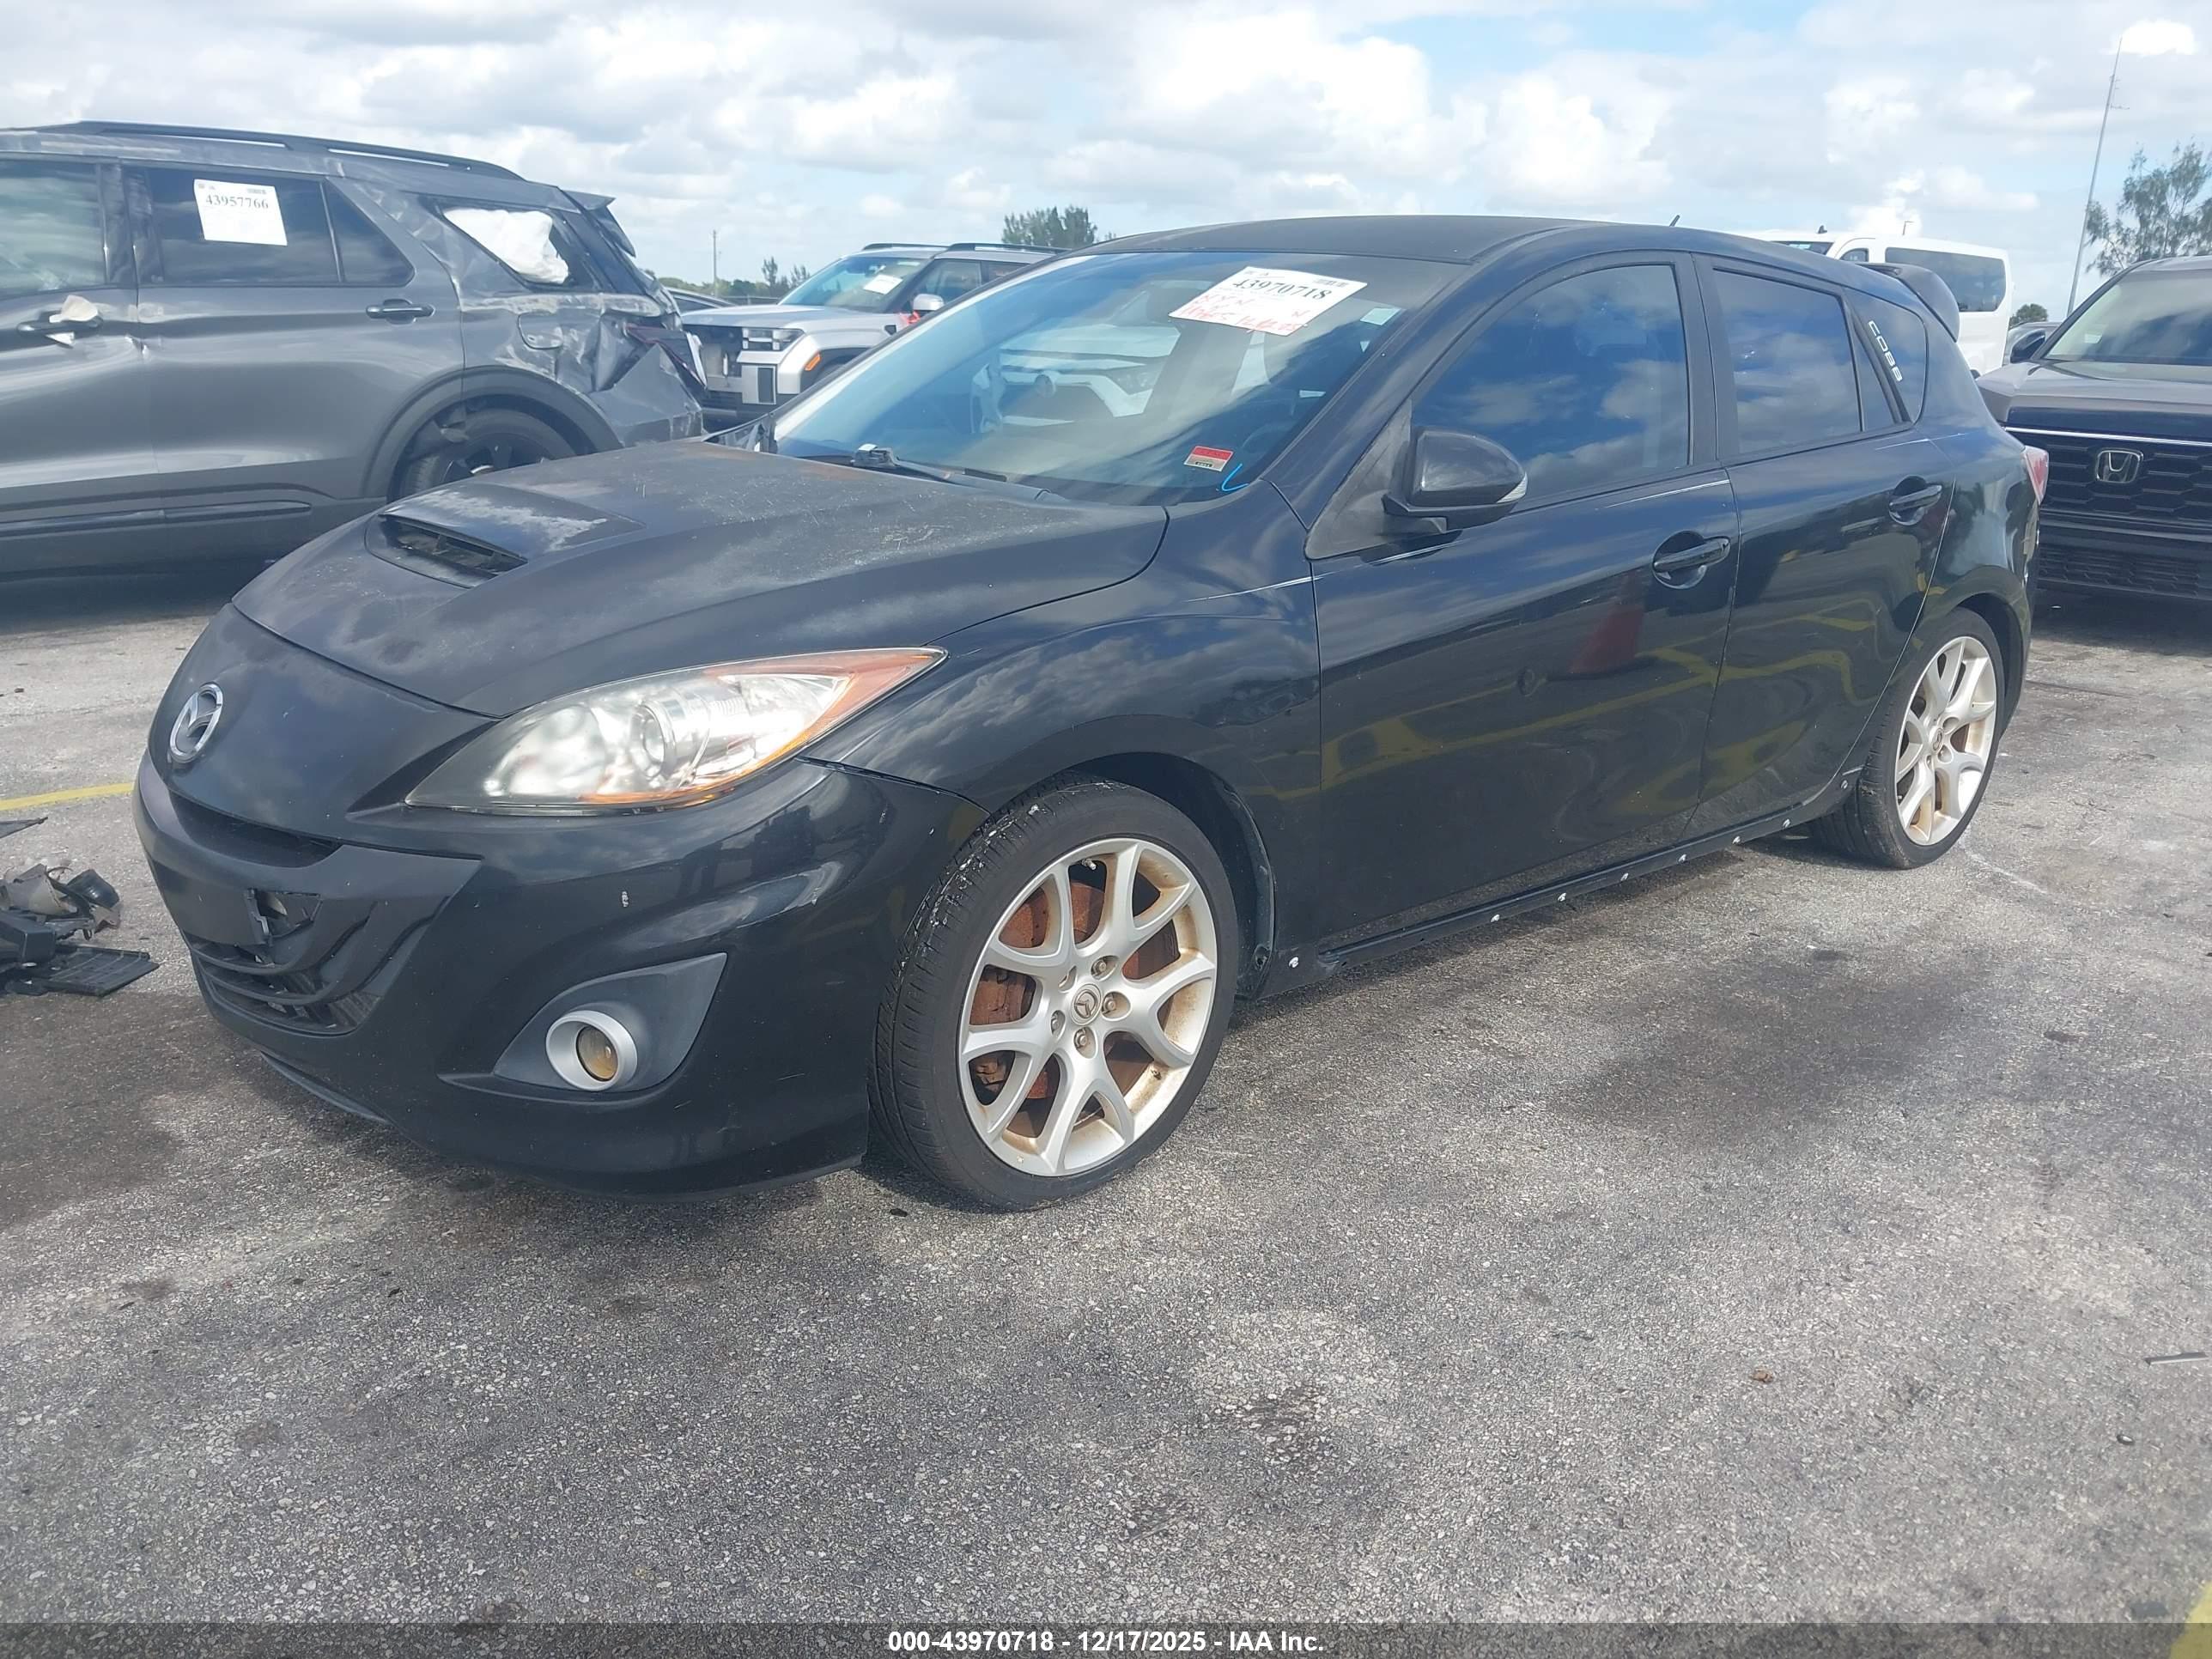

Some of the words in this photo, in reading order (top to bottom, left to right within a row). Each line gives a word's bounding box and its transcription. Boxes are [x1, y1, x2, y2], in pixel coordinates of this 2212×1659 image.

[205, 194, 269, 209] 43957766
[1232, 277, 1332, 301] 43970718
[1868, 319, 1903, 382] COBB
